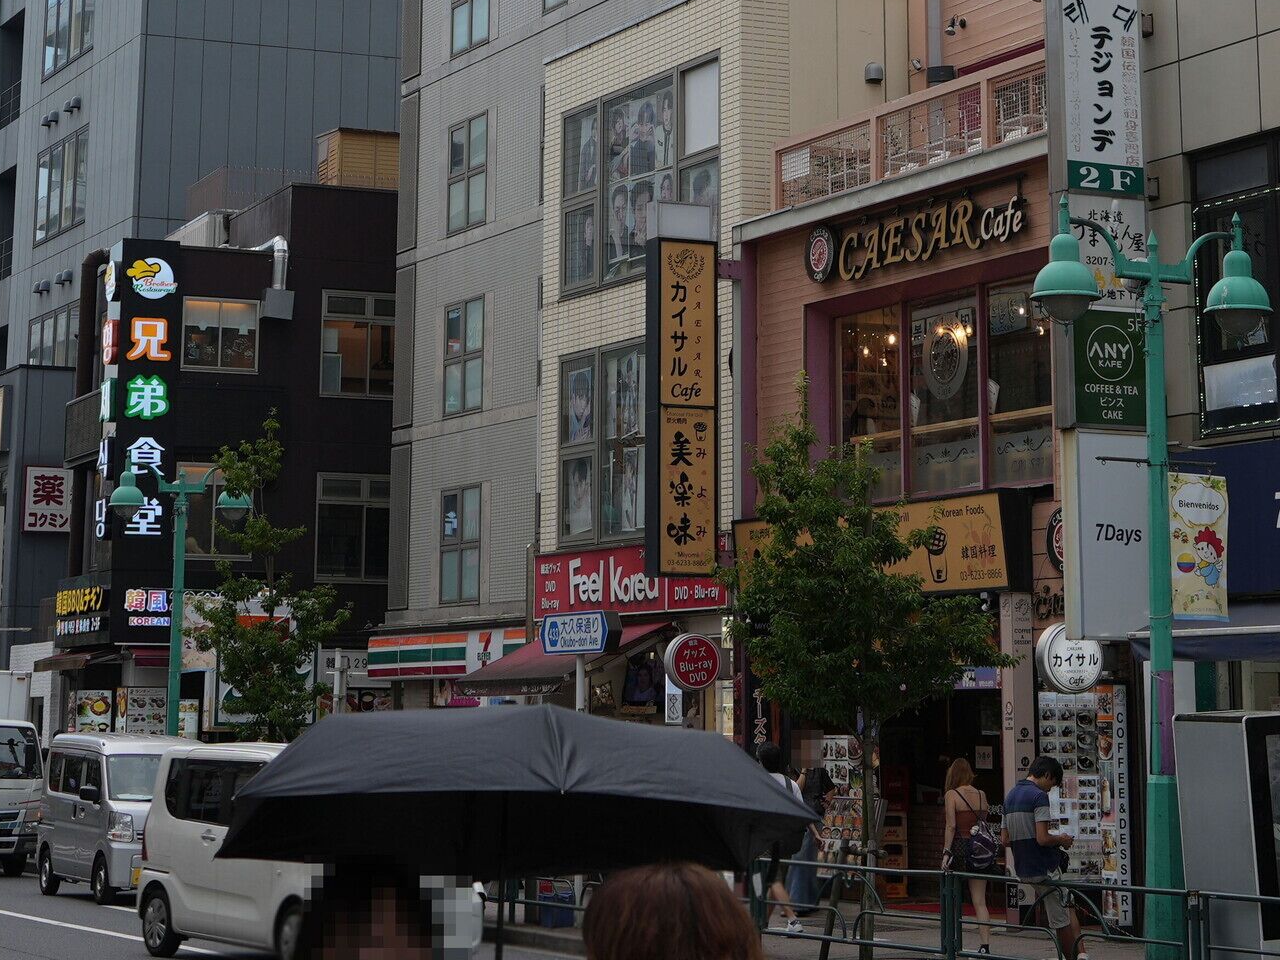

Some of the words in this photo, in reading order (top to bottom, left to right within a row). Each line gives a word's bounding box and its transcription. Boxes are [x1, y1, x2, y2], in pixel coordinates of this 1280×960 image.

[1091, 25, 1116, 152] テジョンデ
[1079, 165, 1136, 191] 2F
[838, 199, 982, 282] CAESAR
[980, 194, 1023, 243] Cafe
[670, 280, 688, 377] カイサル
[693, 283, 703, 379] CAESAR
[1089, 342, 1130, 360] ANY
[1098, 359, 1123, 369] KAFE
[671, 381, 703, 403] Cafe
[1084, 383, 1115, 394] COFFEE
[1123, 385, 1138, 396] TEA
[1102, 409, 1123, 420] CAKE
[124, 318, 171, 536] 兄弟食堂
[32, 473, 65, 506] 薬
[940, 507, 964, 519] Korean
[965, 504, 985, 516] Foods
[1178, 499, 1220, 511] Bienvenidos
[28, 511, 69, 529] コクミン
[1095, 523, 1143, 547] 7Days
[960, 543, 998, 561] 韓国料理
[545, 581, 557, 593] DVD
[569, 557, 605, 606] Feel
[674, 585, 689, 601] DVD
[694, 584, 720, 600] Blu-ray
[541, 597, 560, 611] Blu-ray
[128, 616, 170, 627] KOREAN
[560, 616, 600, 635] 大久保通り
[683, 646, 708, 659] グッズ
[1052, 652, 1099, 669] カイサル
[679, 659, 714, 674] Blu-ray
[689, 670, 709, 684] DVD
[1068, 675, 1085, 687] Cafe
